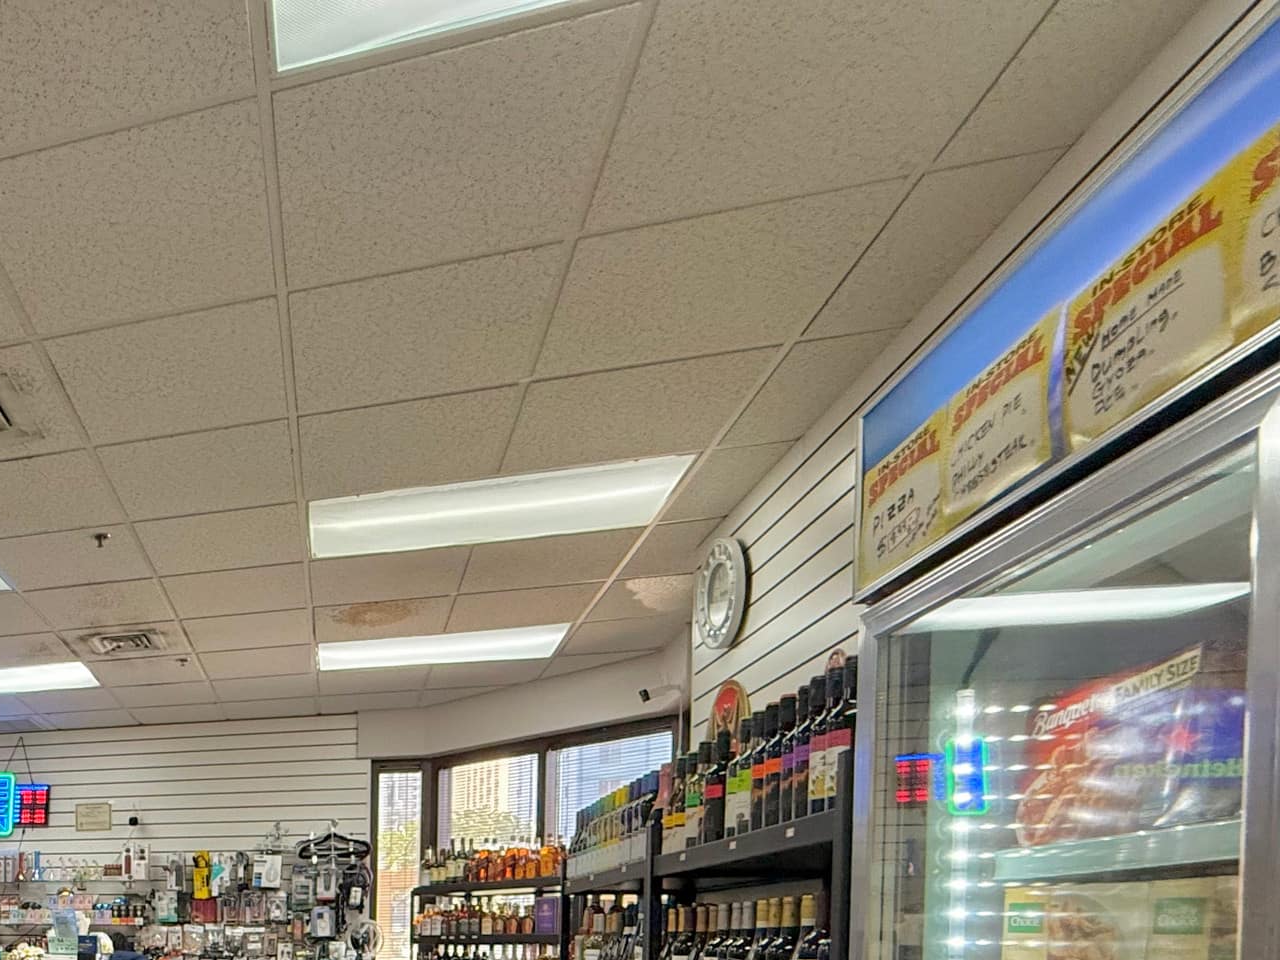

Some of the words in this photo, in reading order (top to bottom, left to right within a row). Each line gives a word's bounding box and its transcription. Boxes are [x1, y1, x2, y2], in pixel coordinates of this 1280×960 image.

[1072, 196, 1223, 345] SPECIAL
[951, 334, 1046, 437] SPECIAL
[1166, 655, 1198, 682] SIZE
